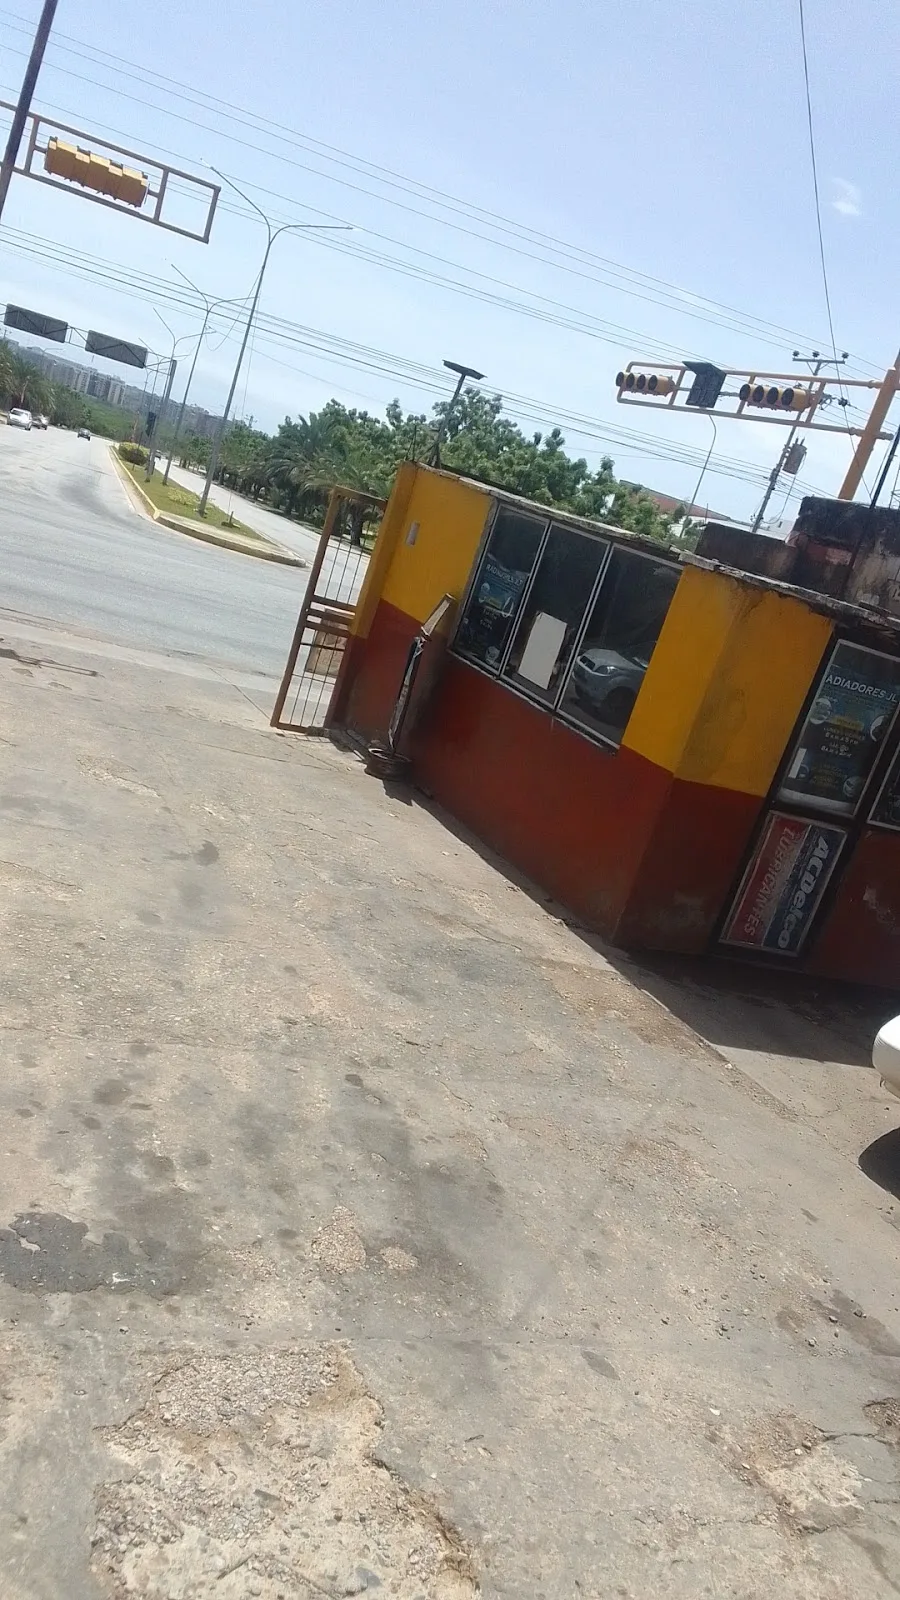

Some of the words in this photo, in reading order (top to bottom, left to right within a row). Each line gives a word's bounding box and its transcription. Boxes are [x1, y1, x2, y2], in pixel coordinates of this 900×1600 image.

[826, 675, 885, 698] ADIADORES
[744, 826, 795, 936] LUBRICANTES
[778, 836, 829, 949] ACDelco
